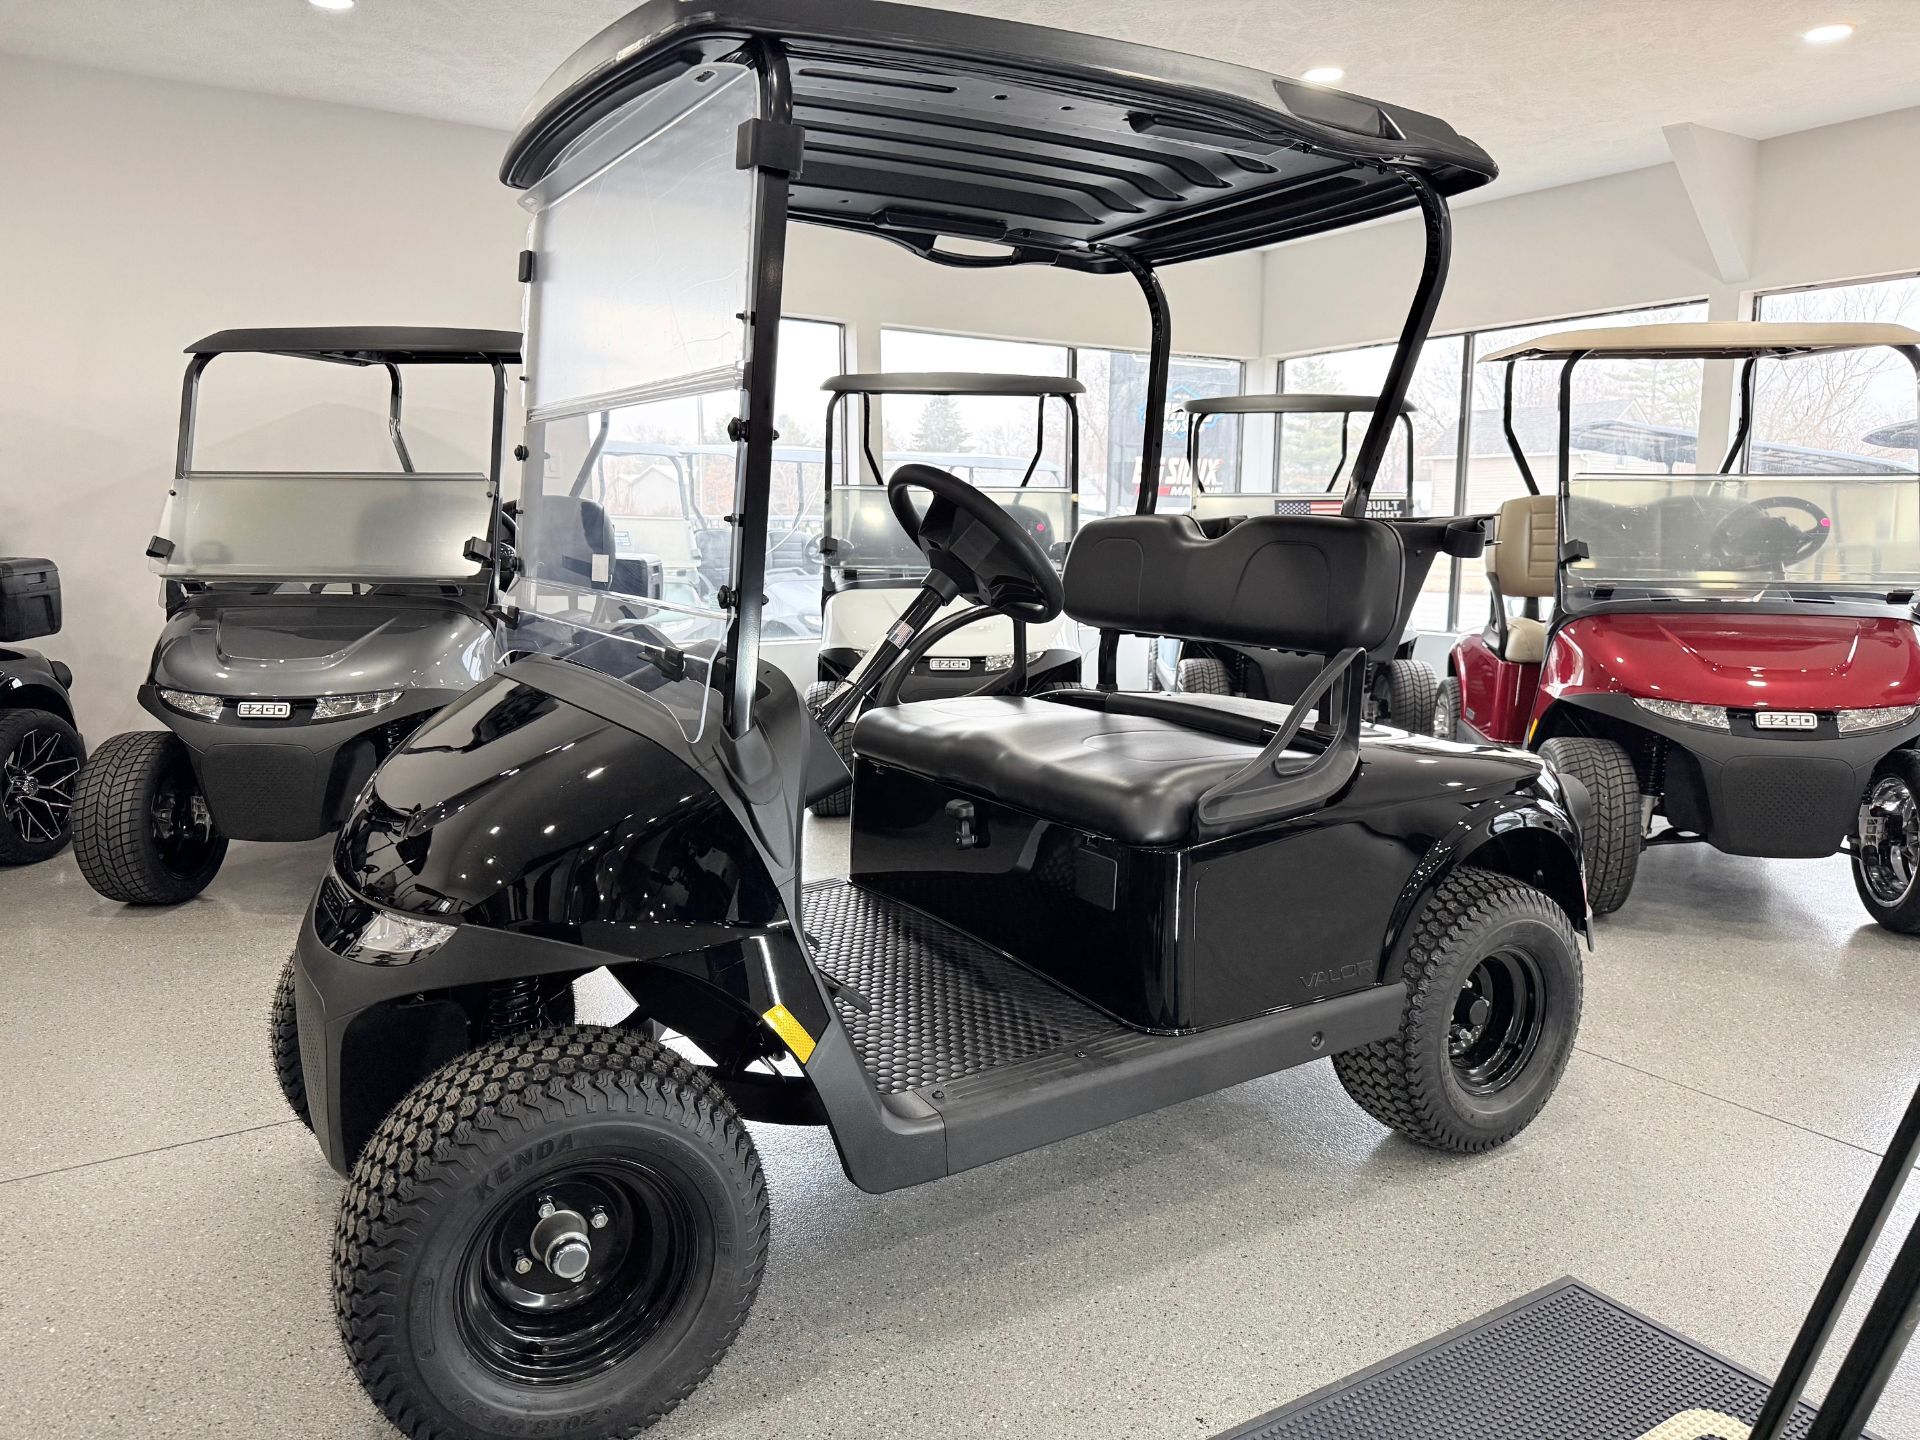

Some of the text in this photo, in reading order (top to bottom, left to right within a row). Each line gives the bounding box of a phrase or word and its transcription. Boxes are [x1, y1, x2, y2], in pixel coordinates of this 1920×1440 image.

[1170, 486, 1222, 496] MANE
[1366, 501, 1400, 511] BUILT
[1299, 960, 1376, 993] VALOR
[474, 1133, 575, 1201] KENDA
